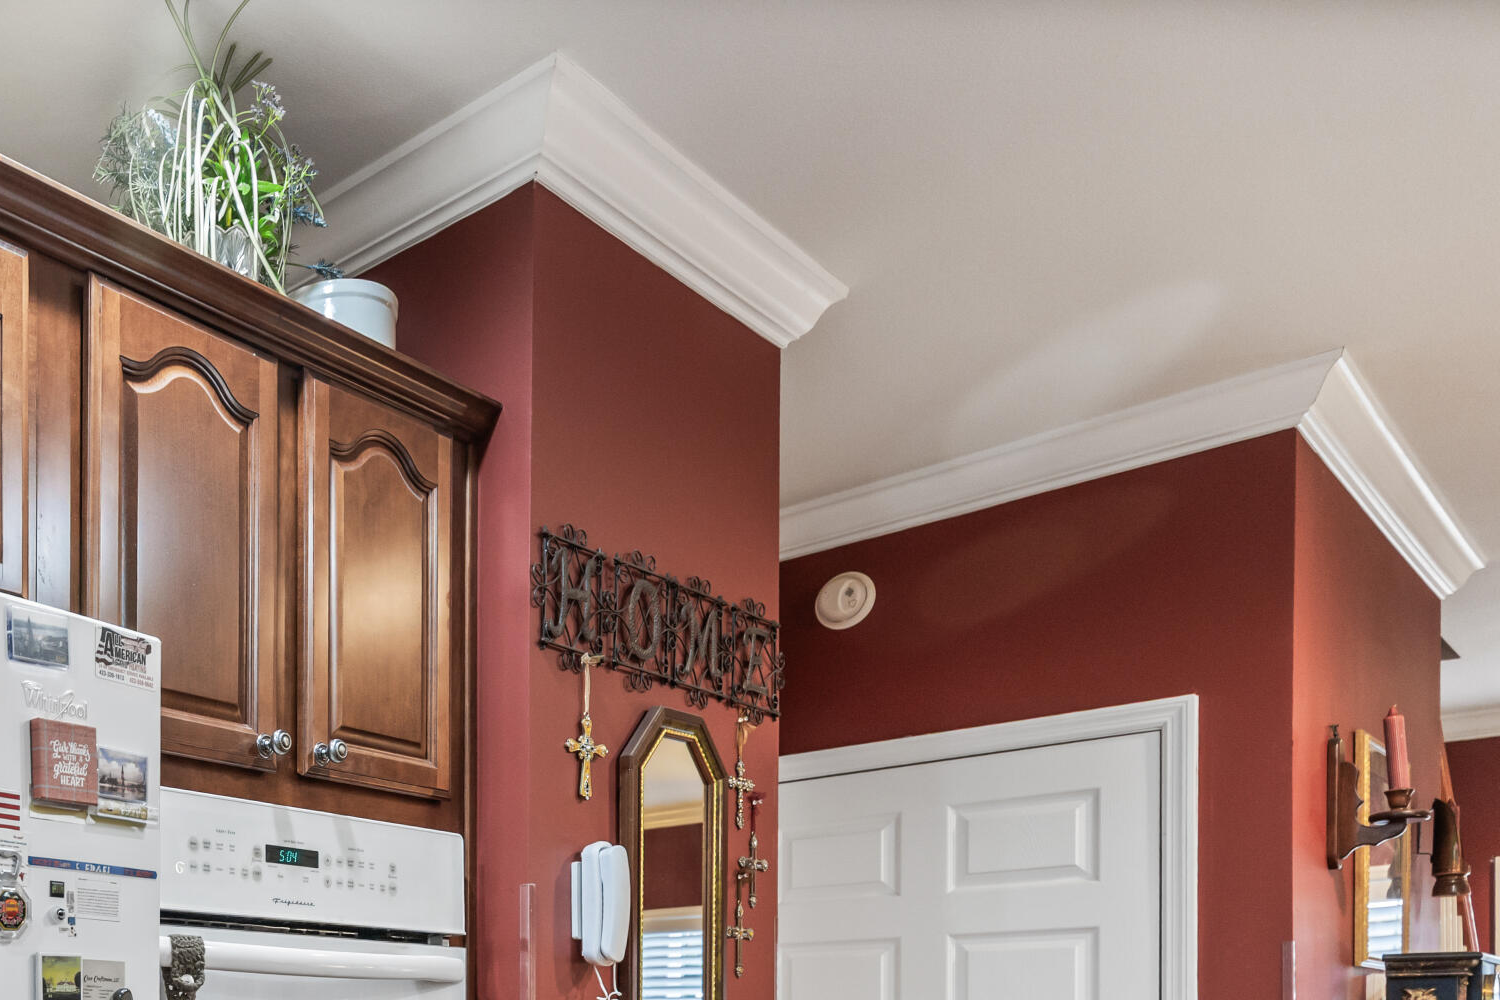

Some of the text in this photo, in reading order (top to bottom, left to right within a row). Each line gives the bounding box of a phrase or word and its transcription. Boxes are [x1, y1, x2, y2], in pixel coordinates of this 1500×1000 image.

[546, 546, 770, 696] HOME
[20, 680, 88, 720] Whirlpool
[60, 774, 86, 787] HEART
[279, 849, 298, 863] 5:04
[272, 897, 316, 909] Frigidaire
